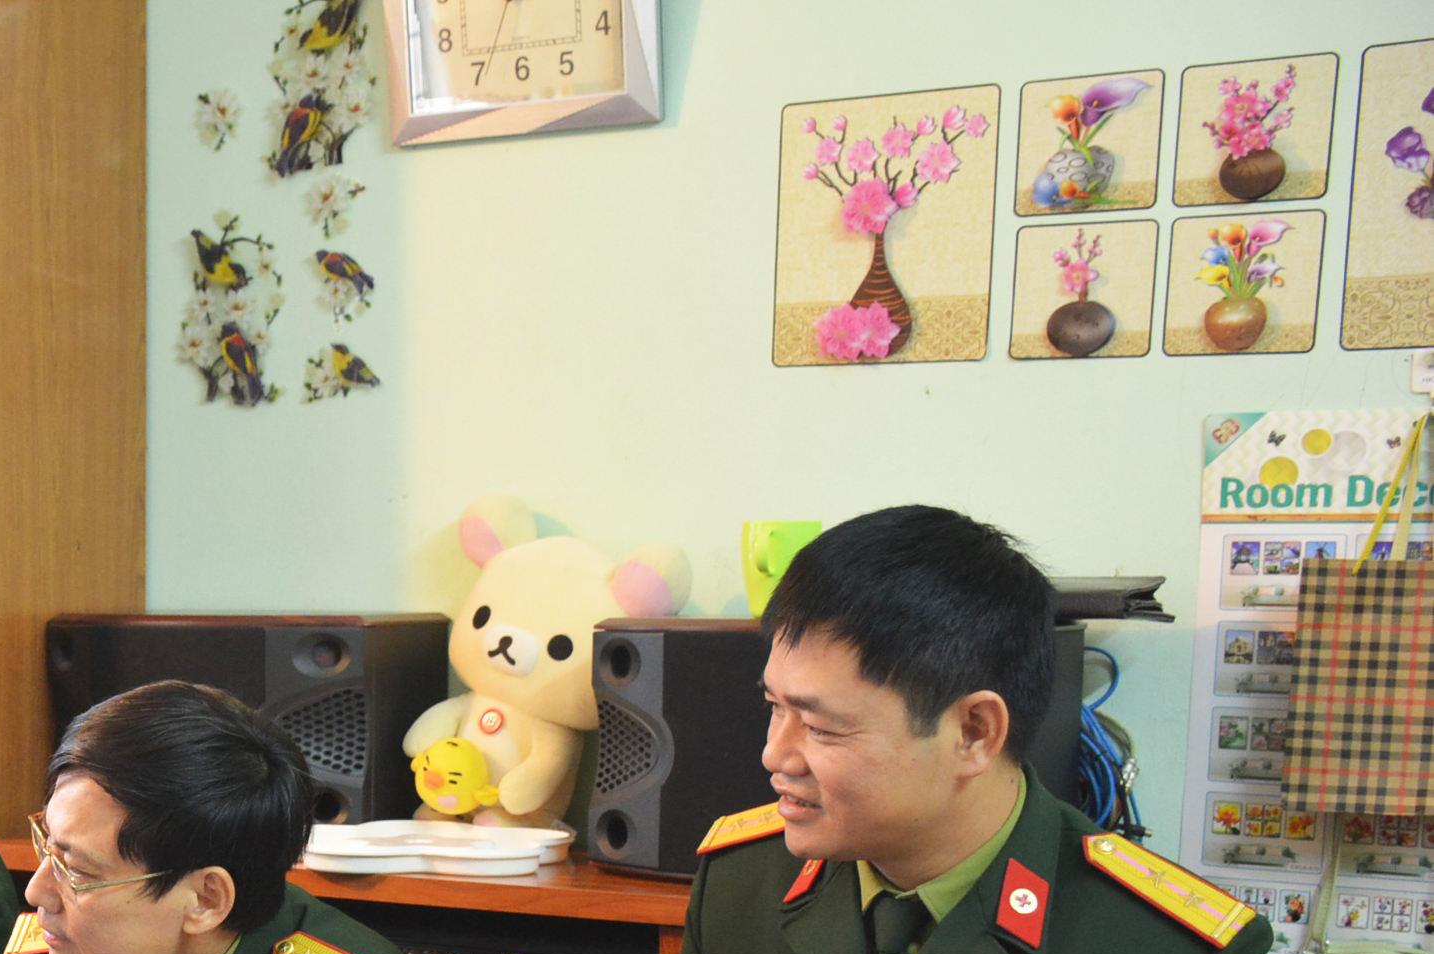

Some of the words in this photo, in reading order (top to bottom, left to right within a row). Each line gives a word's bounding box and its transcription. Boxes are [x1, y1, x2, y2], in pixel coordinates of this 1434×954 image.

[595, 10, 611, 35] 4
[438, 28, 453, 53] 8
[470, 61, 486, 86] 7
[515, 56, 530, 81] 6
[559, 51, 574, 76] 5
[1220, 477, 1332, 509] Room
[1346, 474, 1434, 508] Dec
